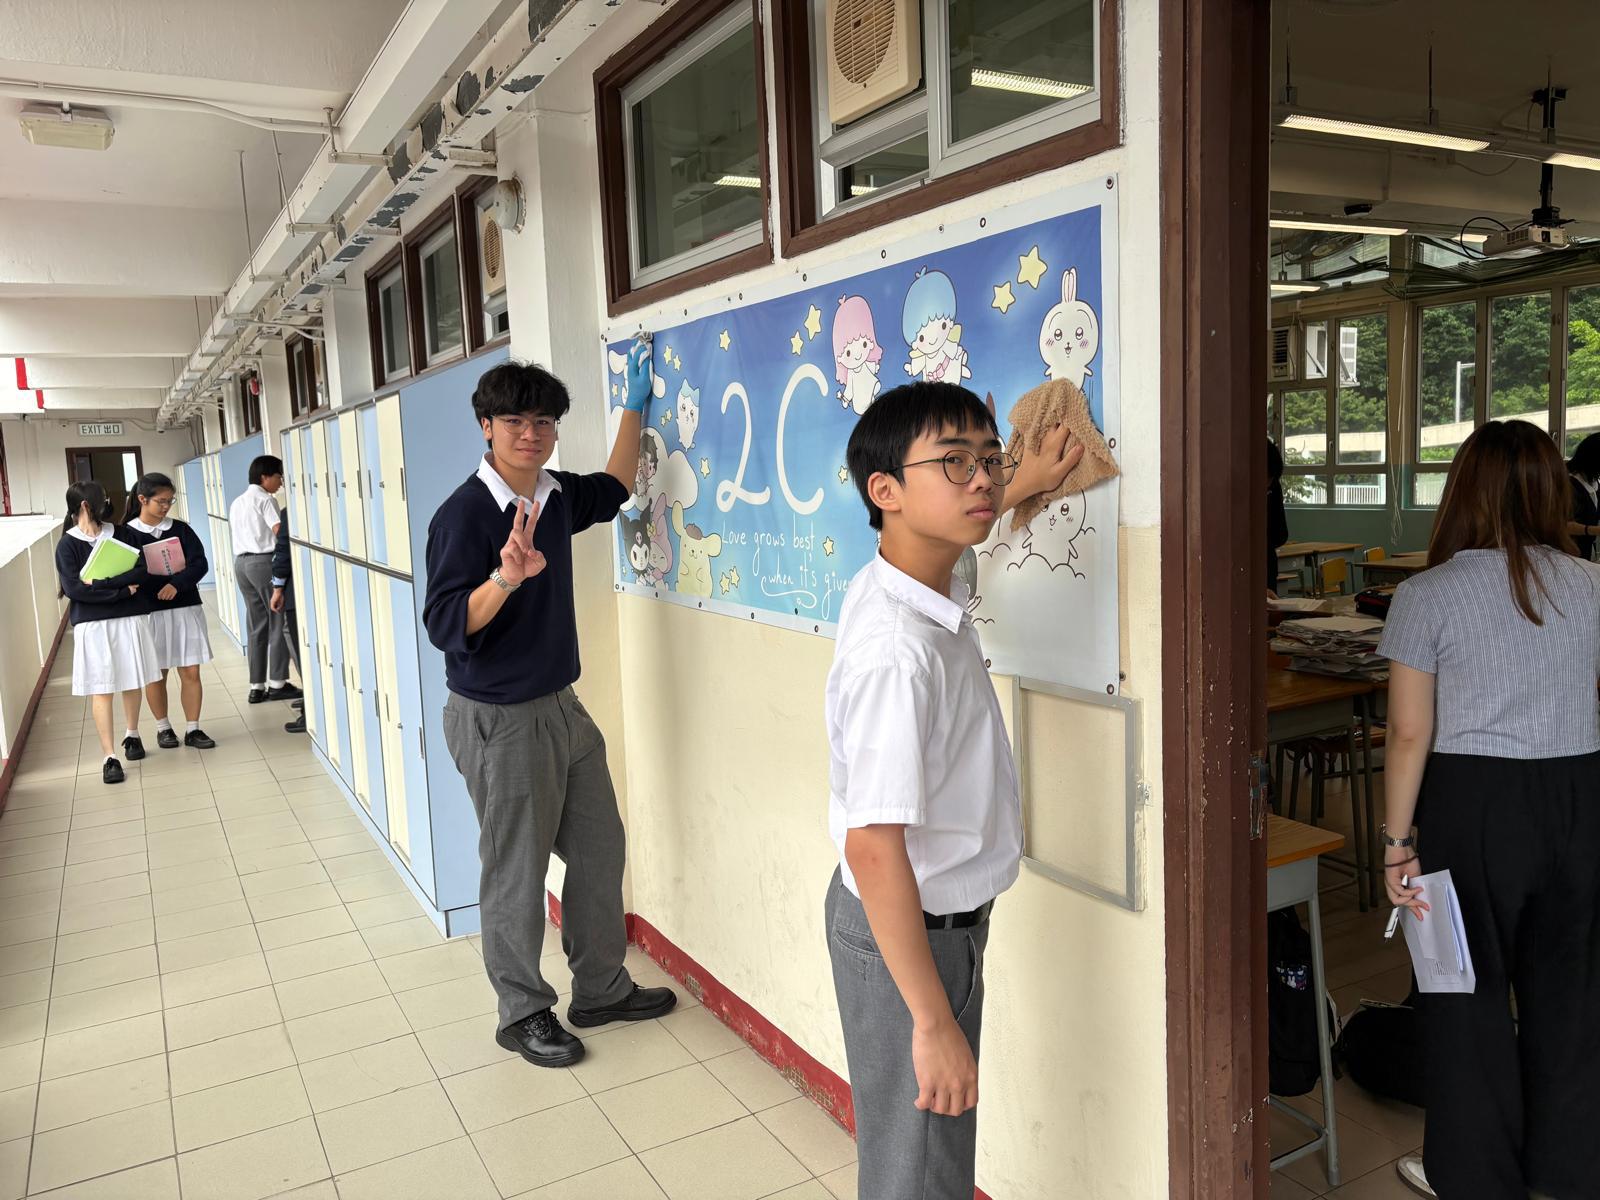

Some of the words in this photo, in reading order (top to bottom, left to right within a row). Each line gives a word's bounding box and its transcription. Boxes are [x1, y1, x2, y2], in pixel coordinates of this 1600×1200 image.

[81, 424, 101, 434] EXIT
[103, 424, 120, 434] 出口
[716, 363, 829, 515] 2C
[722, 520, 747, 545] Love
[752, 532, 785, 577] grows
[793, 511, 815, 550] best
[768, 551, 794, 585] when
[799, 551, 817, 588] it's
[821, 571, 849, 620] give
